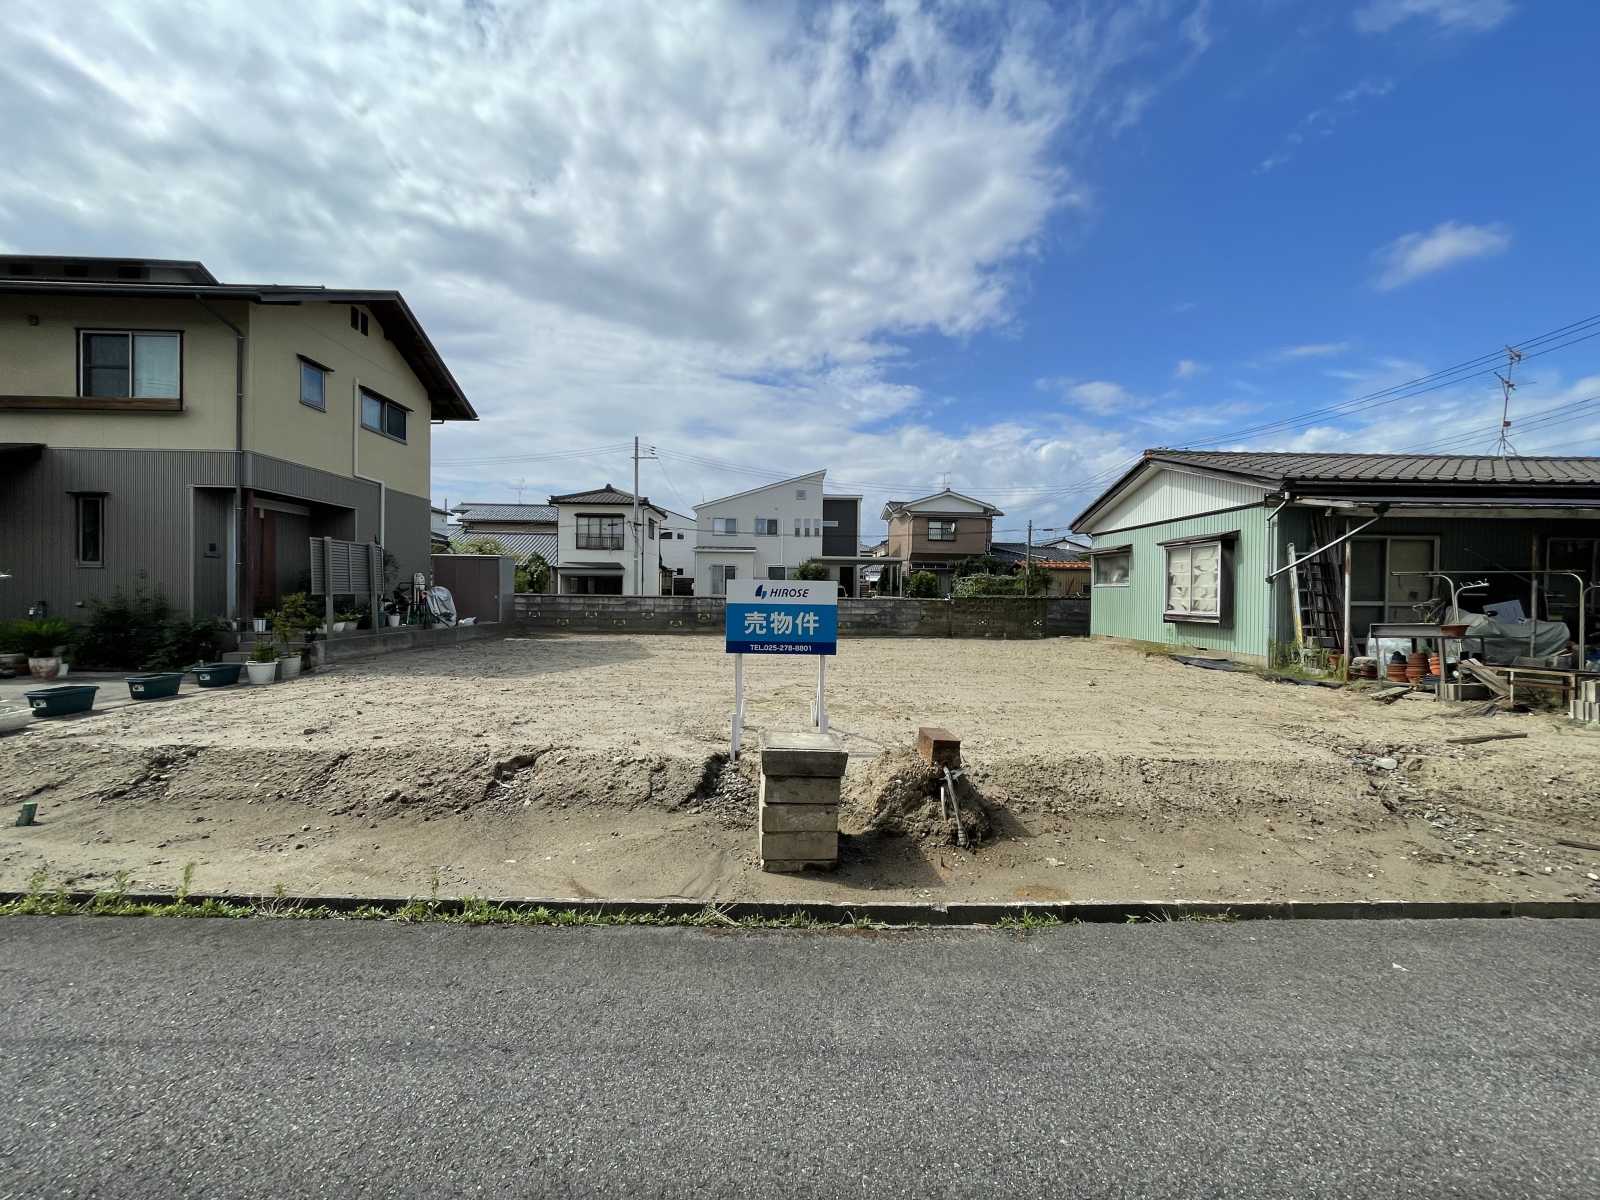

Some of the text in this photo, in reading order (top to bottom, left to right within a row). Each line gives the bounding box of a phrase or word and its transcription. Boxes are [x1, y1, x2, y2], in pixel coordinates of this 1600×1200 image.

[769, 588, 810, 598] HIROSE
[744, 611, 820, 636] 売物件
